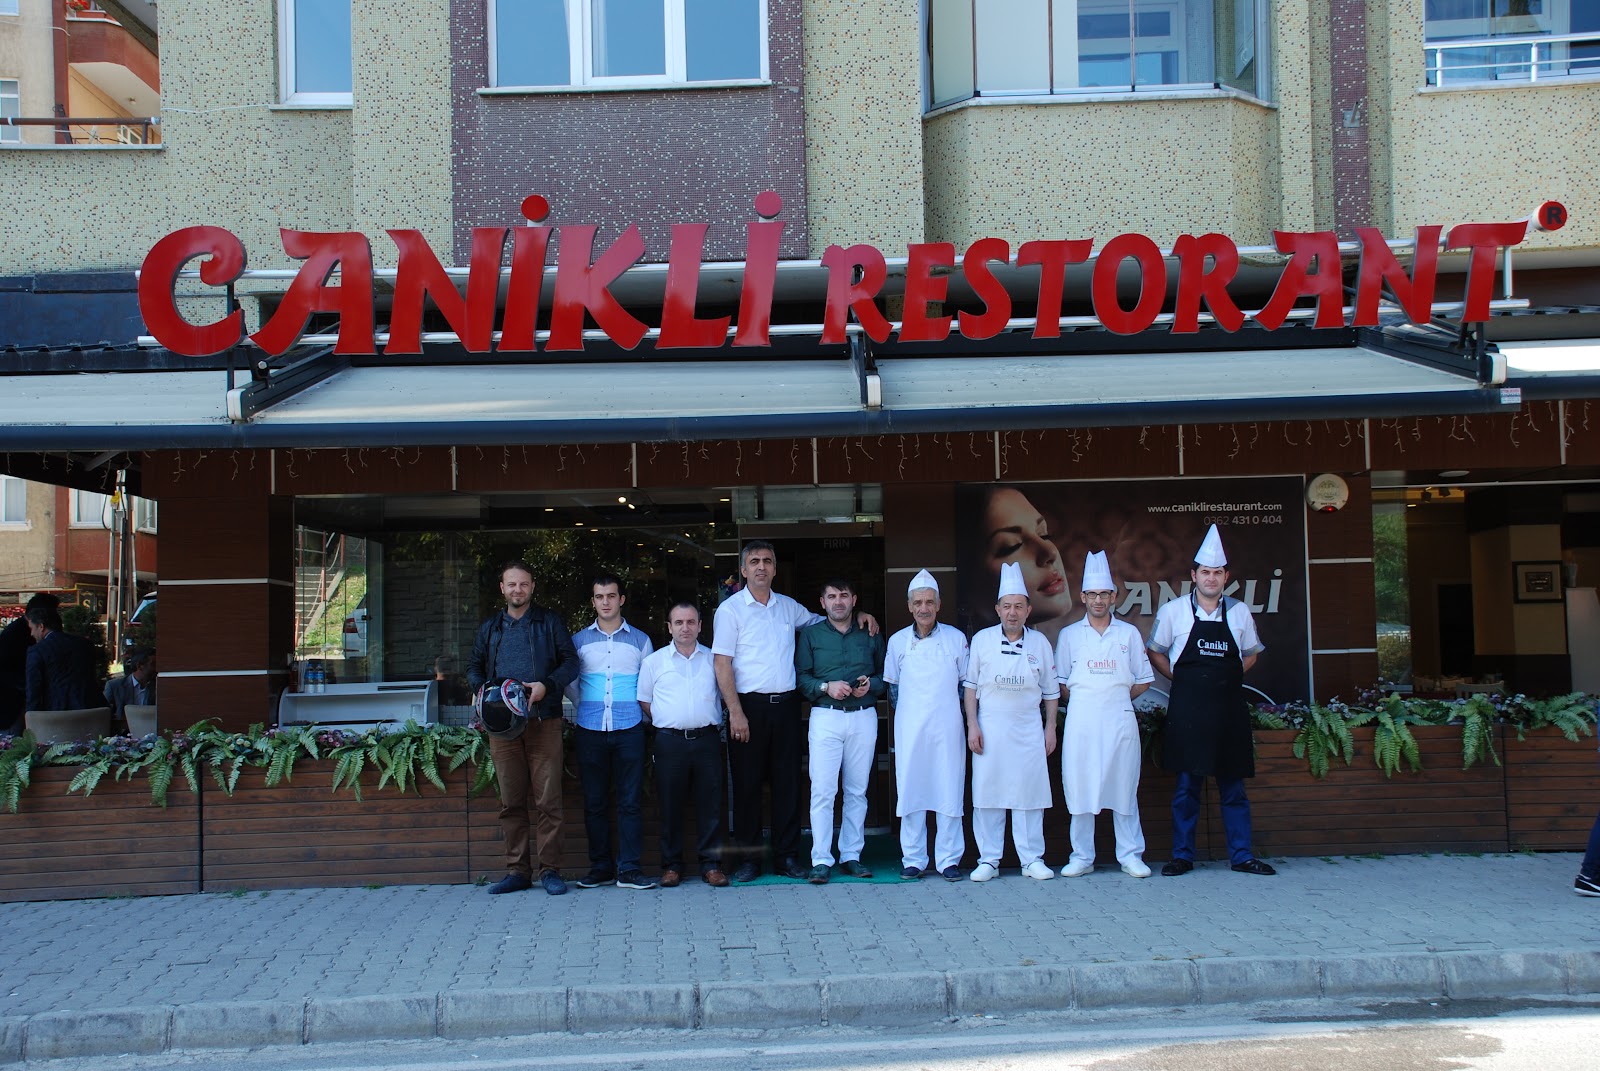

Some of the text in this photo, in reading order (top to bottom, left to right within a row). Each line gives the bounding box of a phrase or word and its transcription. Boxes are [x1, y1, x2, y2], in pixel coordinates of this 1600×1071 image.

[820, 221, 1529, 345] RESTORANT
[1147, 501, 1282, 512] www.caniklirestaurant.com
[1197, 638, 1228, 651] Canikli
[1087, 659, 1117, 669] Canikli
[994, 674, 1025, 686] Canikli
